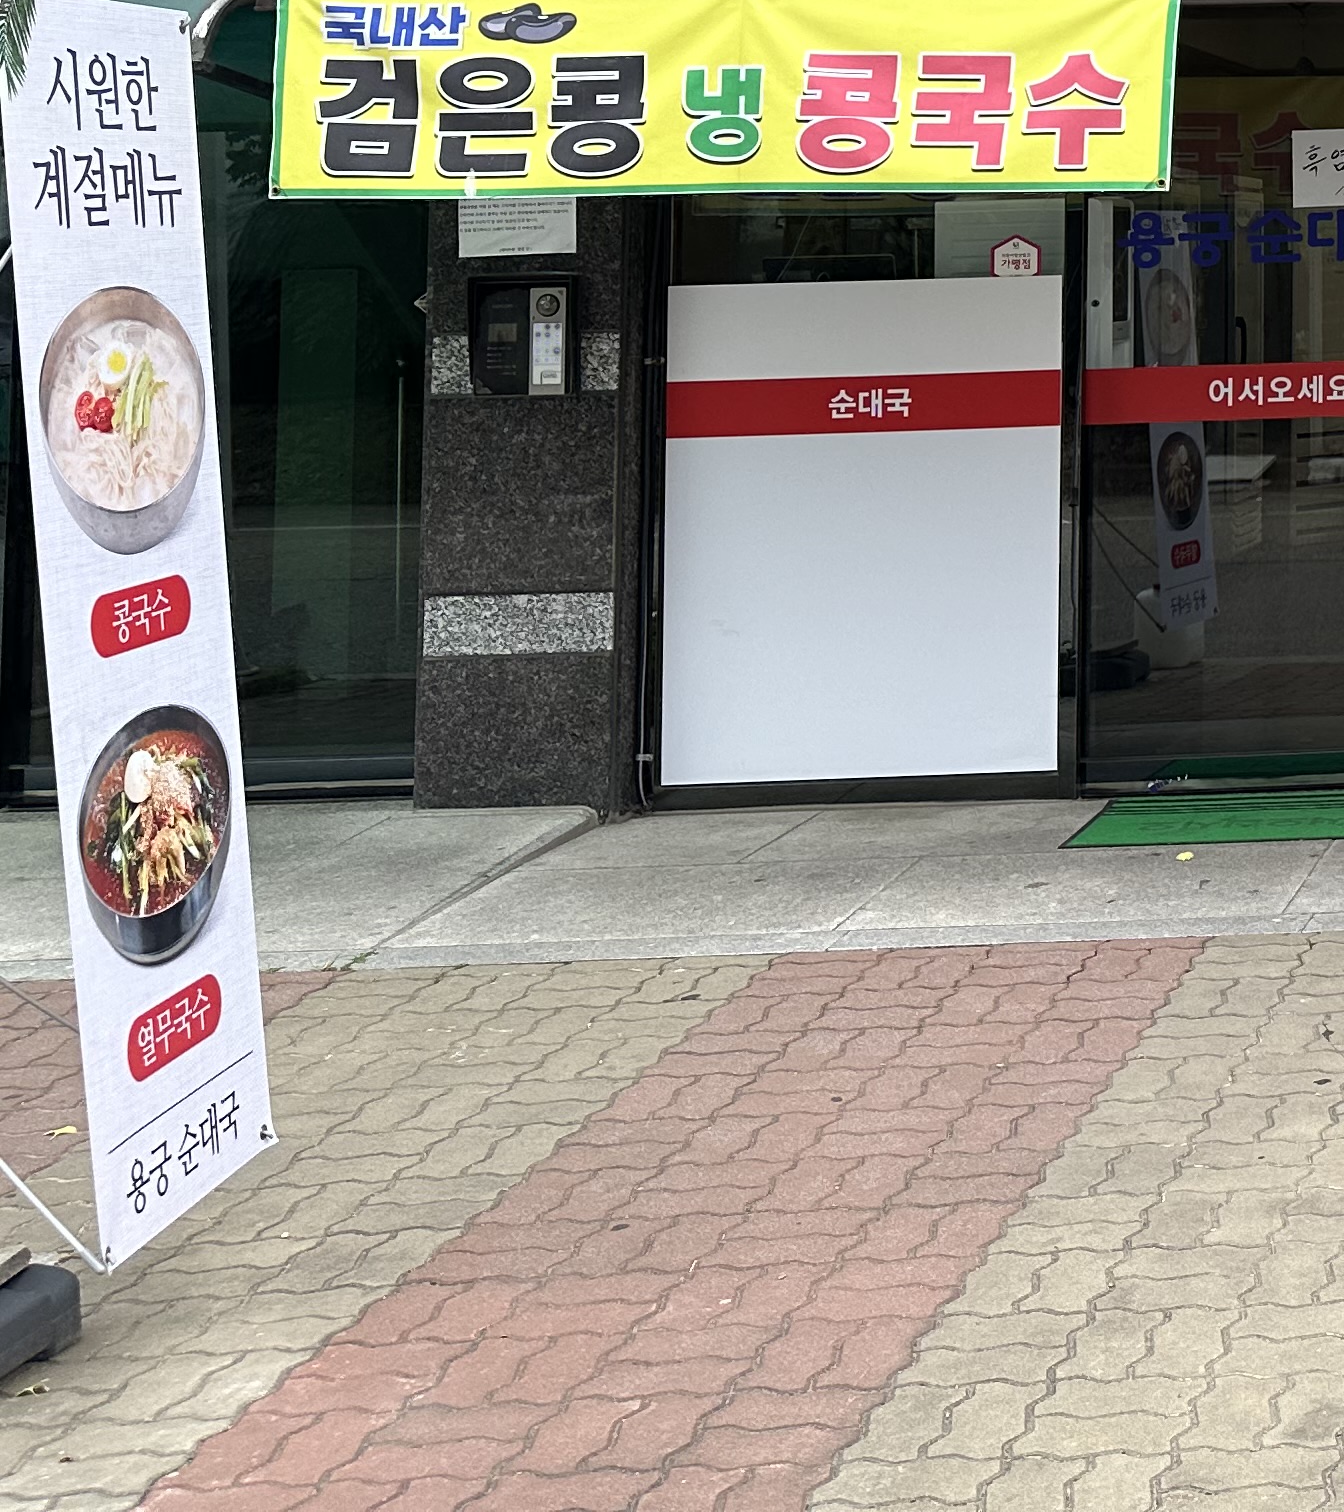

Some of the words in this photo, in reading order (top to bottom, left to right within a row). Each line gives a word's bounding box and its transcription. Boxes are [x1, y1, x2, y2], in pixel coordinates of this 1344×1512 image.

[322, 3, 467, 50] 국내산
[46, 46, 159, 135] 시원한
[314, 52, 647, 180] 검은콩
[682, 65, 763, 163] 냉
[796, 50, 1130, 175] 콩국수
[32, 146, 184, 231] 계절메뉴
[1001, 258, 1031, 270] 가맹점
[828, 388, 913, 420] 순대국
[111, 587, 172, 643] 콩국수
[136, 986, 211, 1069] 열무국수
[126, 1140, 172, 1215] 용궁
[176, 1091, 240, 1178] 순대국
